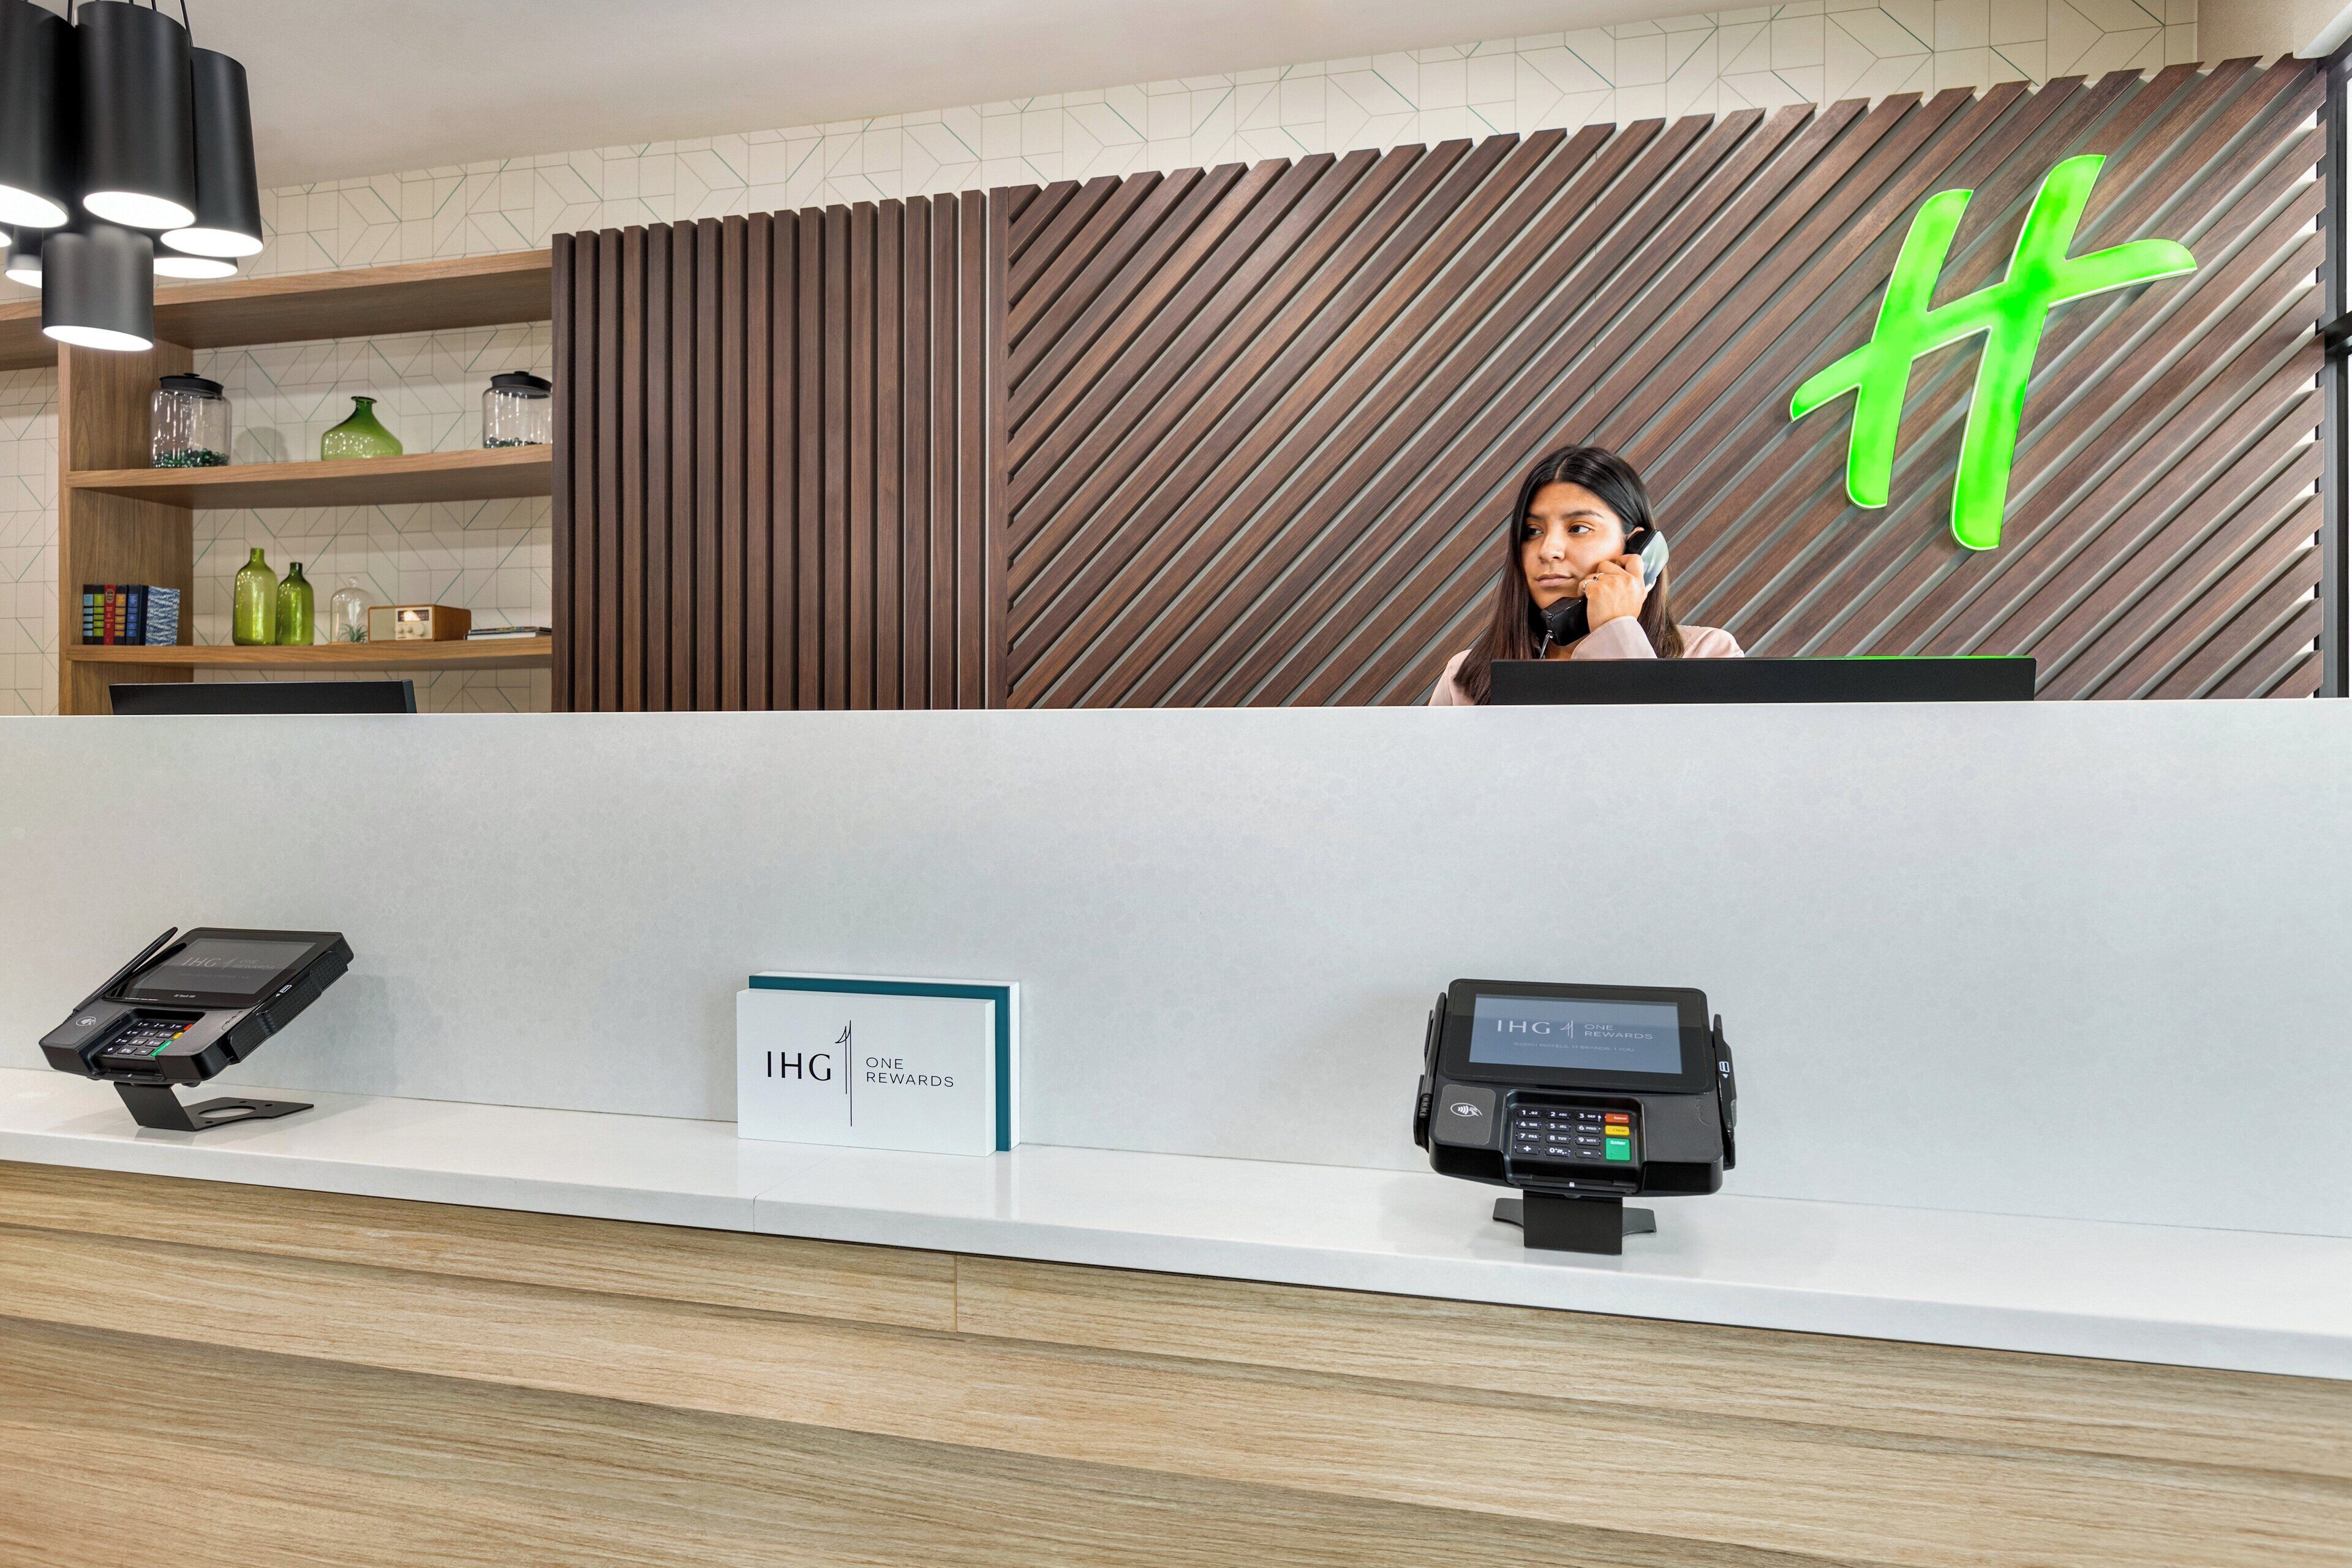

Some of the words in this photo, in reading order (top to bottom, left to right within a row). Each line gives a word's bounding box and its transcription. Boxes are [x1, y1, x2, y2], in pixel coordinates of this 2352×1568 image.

[1790, 154, 2198, 551] H
[181, 957, 221, 967] IHG
[1498, 1020, 1550, 1035] IHG
[767, 1050, 831, 1081] IHG
[865, 1057, 903, 1069] ONE
[867, 1072, 954, 1087] REWARDS
